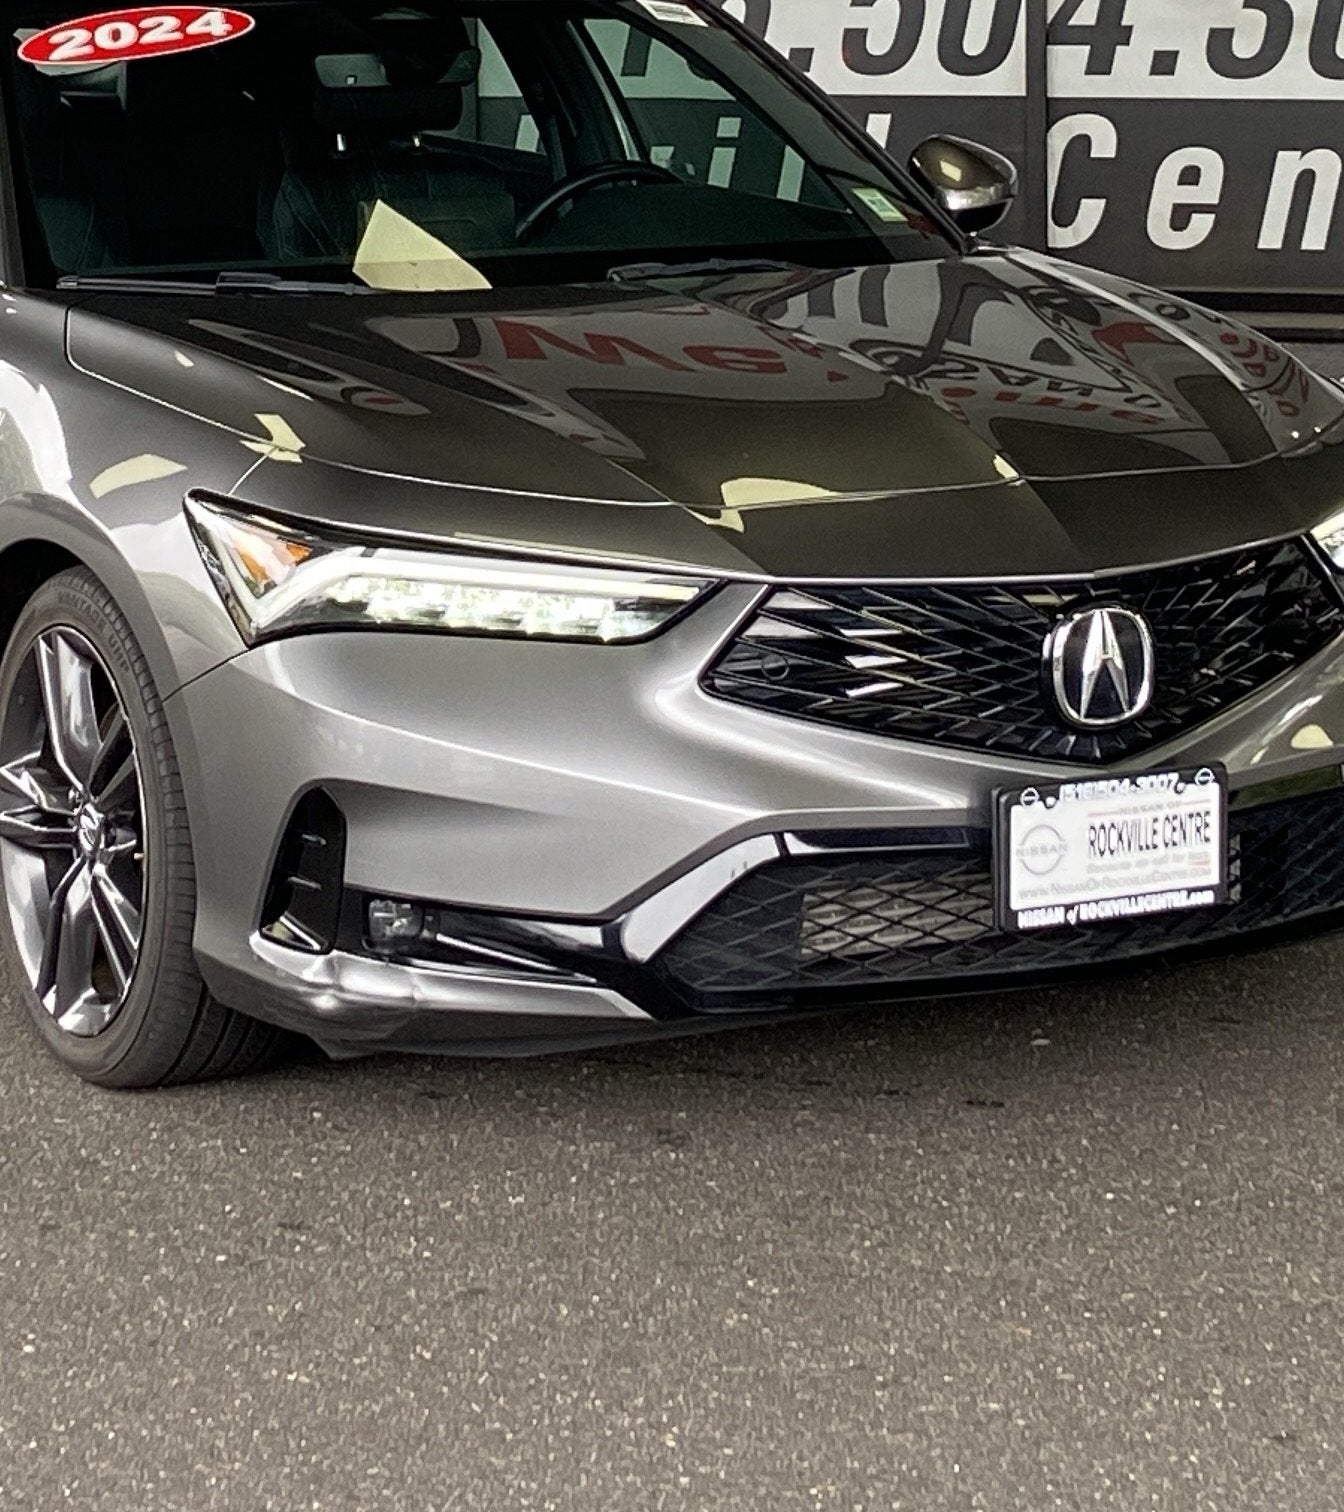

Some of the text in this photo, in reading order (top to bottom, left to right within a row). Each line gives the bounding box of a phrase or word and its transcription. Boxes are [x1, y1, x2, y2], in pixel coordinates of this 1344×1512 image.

[49, 11, 233, 61] 2024
[1016, 843, 1068, 857] NISSAN
[1088, 810, 1211, 859] ROCKVILLE CENTRE
[1018, 906, 1065, 929] NISSAN
